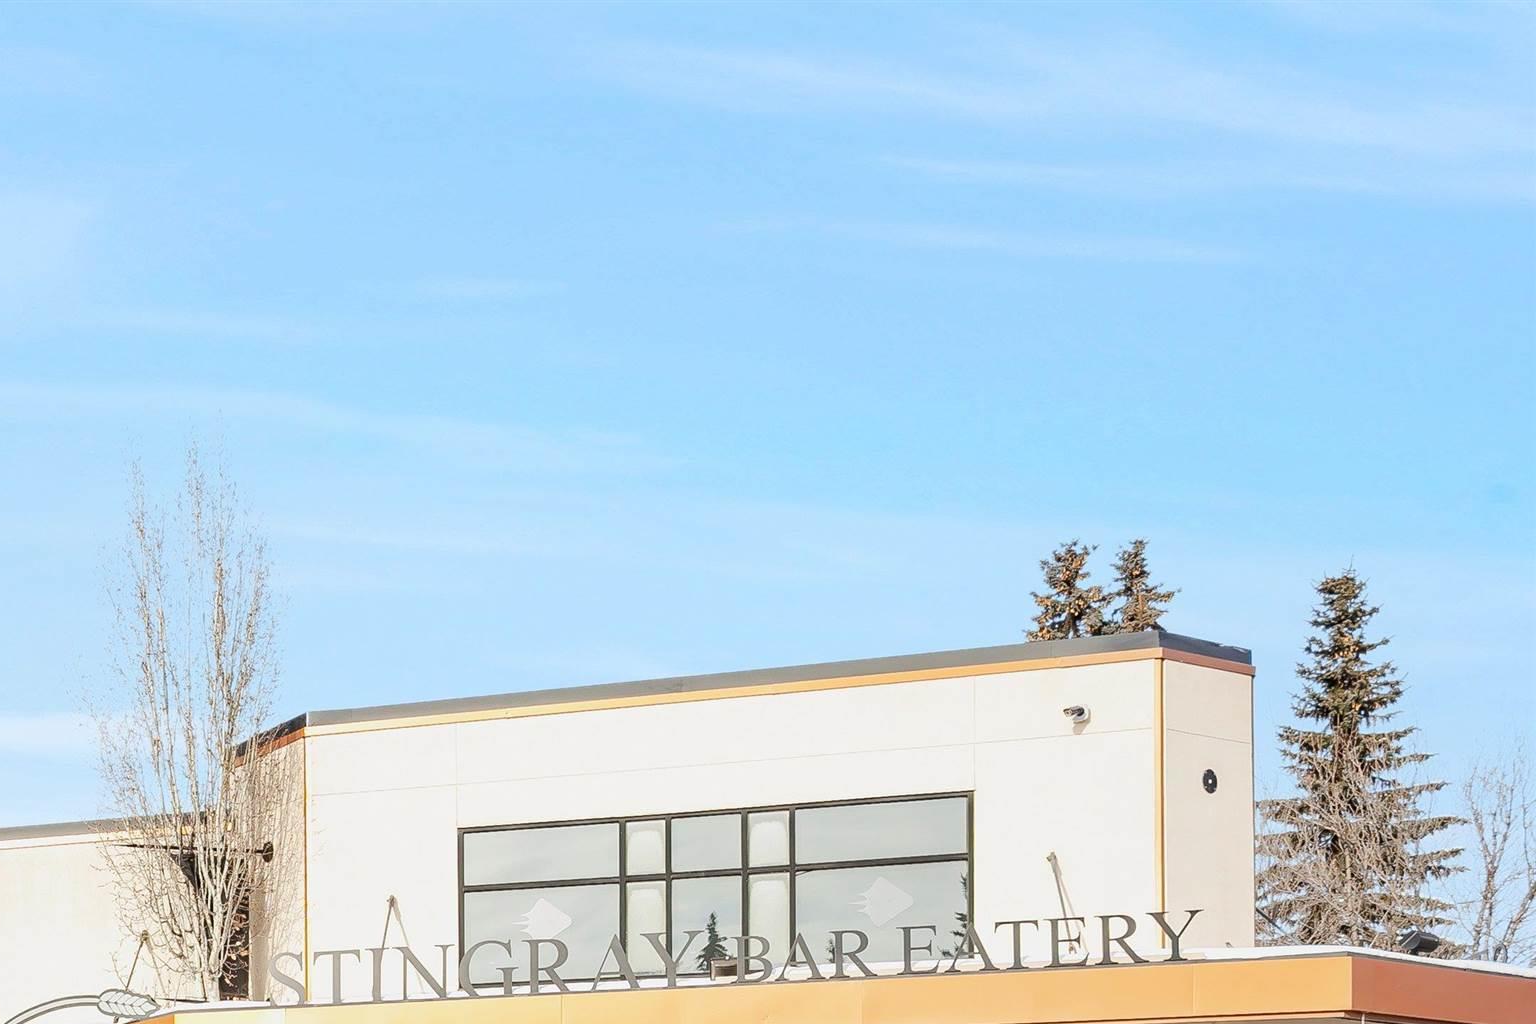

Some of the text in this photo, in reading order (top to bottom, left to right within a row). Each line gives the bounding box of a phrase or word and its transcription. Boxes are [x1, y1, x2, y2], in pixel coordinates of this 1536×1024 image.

[267, 909, 1204, 1007] STINGRAY BAR EATERY
